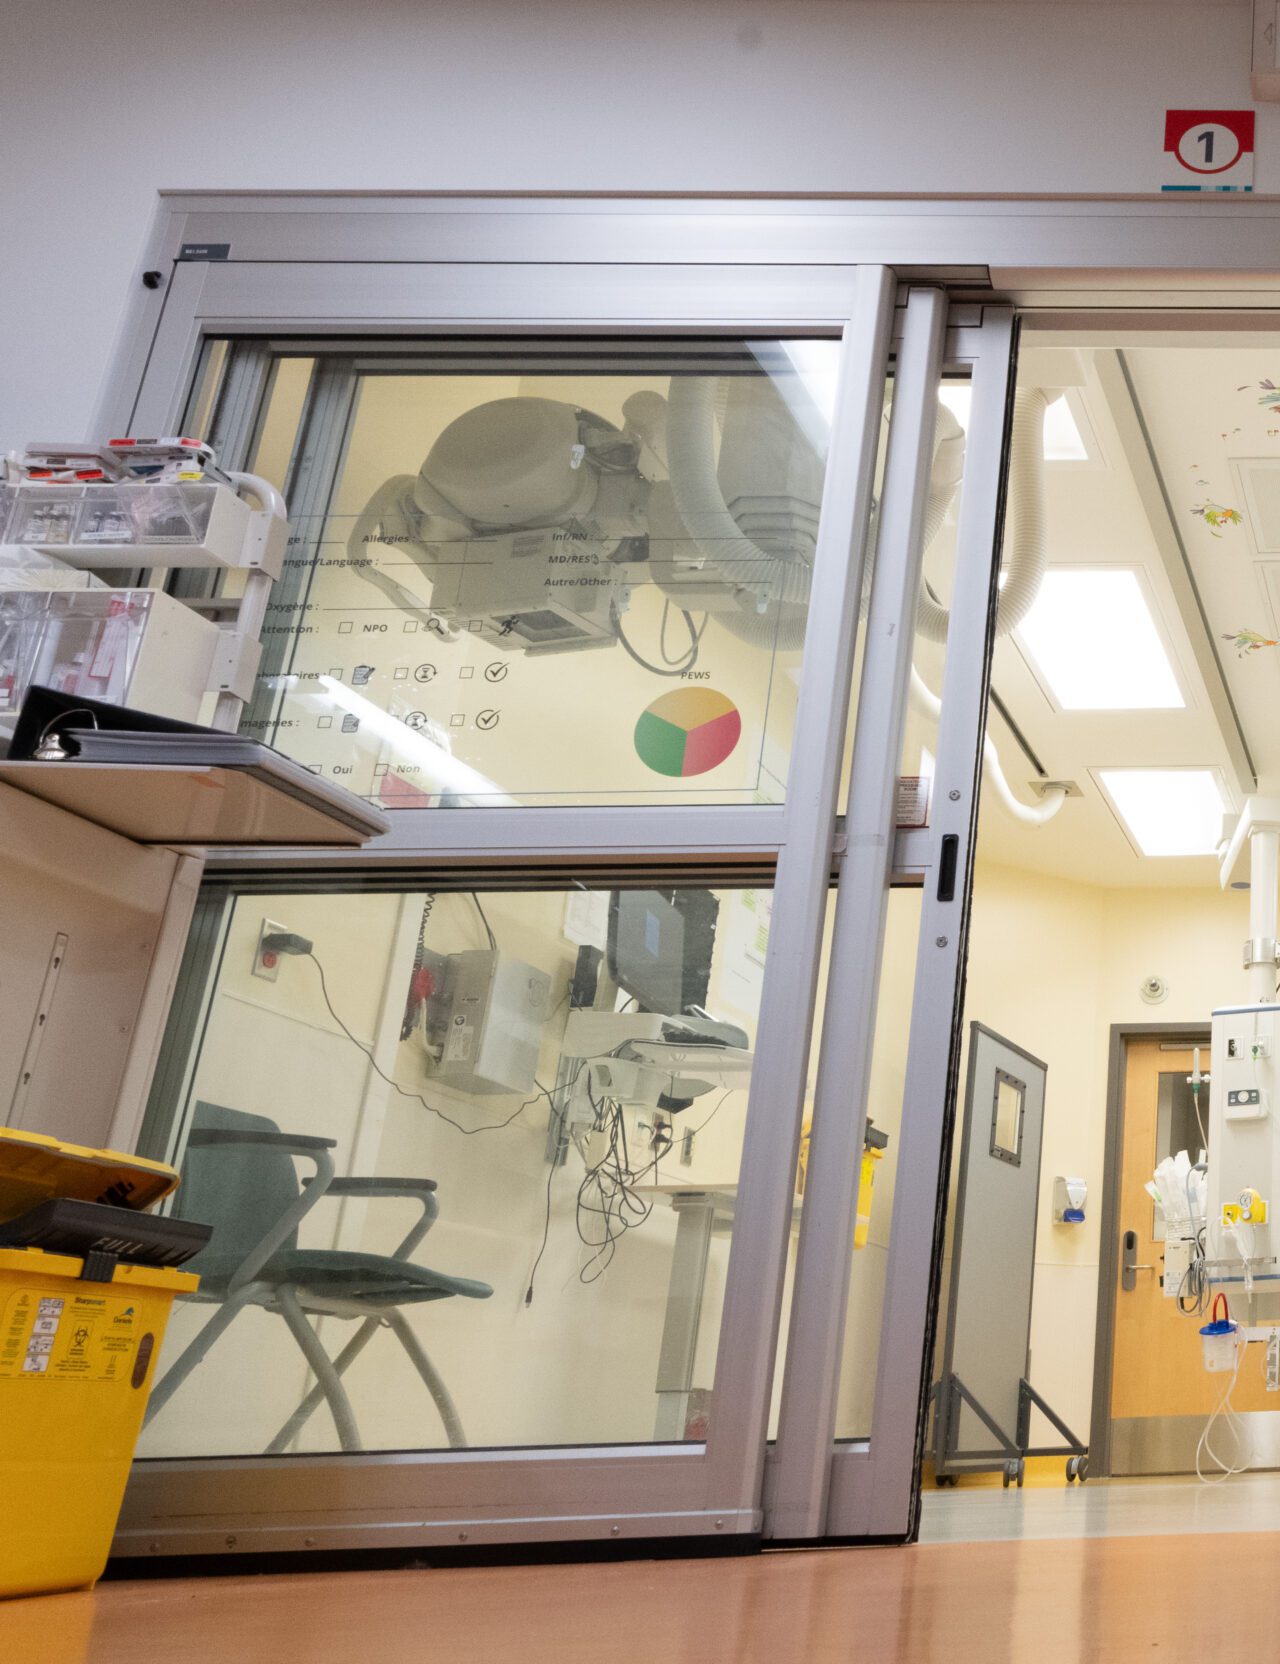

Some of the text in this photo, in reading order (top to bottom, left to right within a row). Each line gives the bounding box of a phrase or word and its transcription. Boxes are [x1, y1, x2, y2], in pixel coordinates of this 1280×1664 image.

[1197, 131, 1214, 163] 1
[361, 535, 409, 544] Allergies
[552, 533, 588, 541] Inf/RN
[283, 558, 373, 568] angue/Language
[544, 578, 612, 586] Autre/Other
[680, 671, 711, 680] PEWS
[240, 719, 293, 730] mageries
[332, 765, 421, 774] Oui Non
[96, 1237, 144, 1254] FULL
